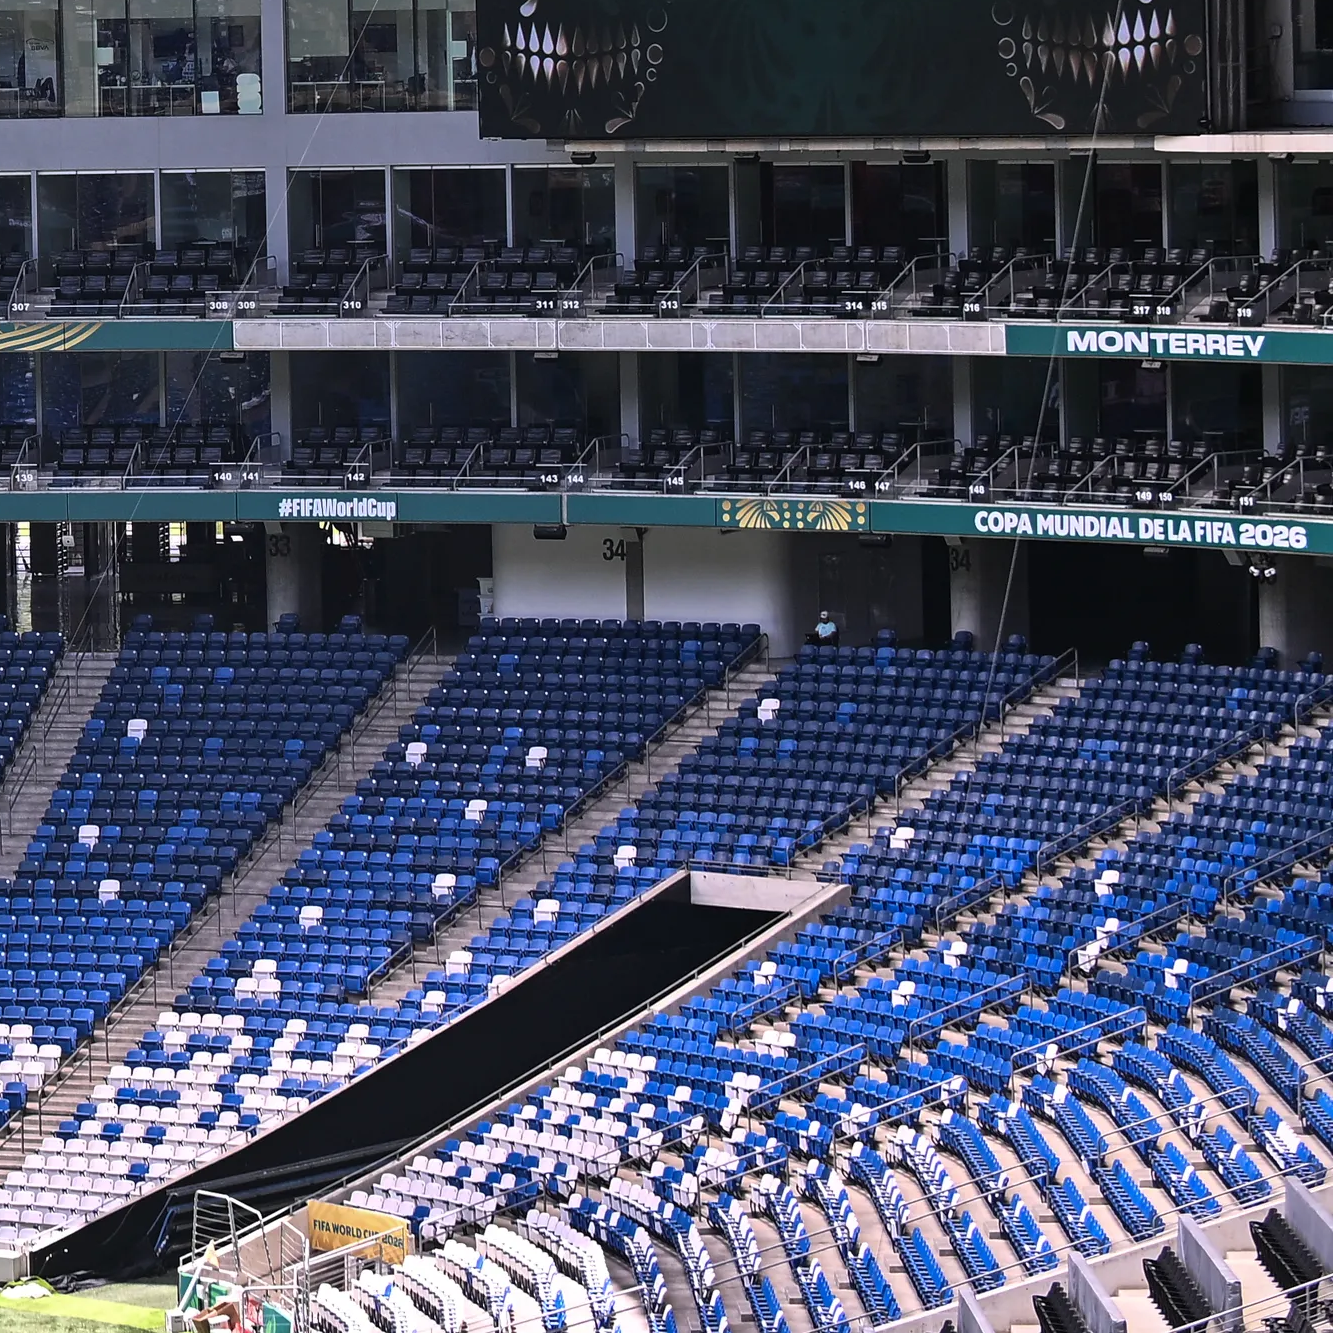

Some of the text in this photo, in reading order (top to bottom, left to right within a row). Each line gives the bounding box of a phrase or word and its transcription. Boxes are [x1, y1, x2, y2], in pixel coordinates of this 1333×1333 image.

[11, 303, 30, 311] 307
[209, 301, 227, 309] 308
[237, 301, 255, 309] 309
[343, 301, 361, 309] 310
[536, 301, 553, 309] 311
[562, 301, 579, 309] 312
[661, 301, 678, 309] 313
[845, 301, 862, 310] 314
[871, 301, 887, 310] 315
[964, 303, 980, 312] 316
[1133, 306, 1149, 315] 317
[1156, 306, 1170, 315] 318
[1237, 308, 1252, 317] 319
[1067, 330, 1265, 358] MONTERREY
[15, 474, 33, 482] 139
[214, 473, 232, 481] 140
[242, 473, 259, 481] 141
[347, 473, 364, 481] 142
[567, 475, 584, 483] 144
[667, 477, 683, 486] 145
[849, 481, 865, 490] 146
[875, 481, 890, 491] 147
[969, 486, 984, 495] 148
[1136, 492, 1152, 501] 149
[1158, 492, 1172, 501] 150
[1239, 497, 1254, 506] 151
[278, 497, 396, 521] #FIFAWorldCup
[974, 510, 1308, 549] COPA MUNDIAL DE LA FIFA 2026
[602, 538, 626, 561] 34
[313, 1219, 331, 1233] FIFA
[332, 1222, 362, 1239] WORLD
